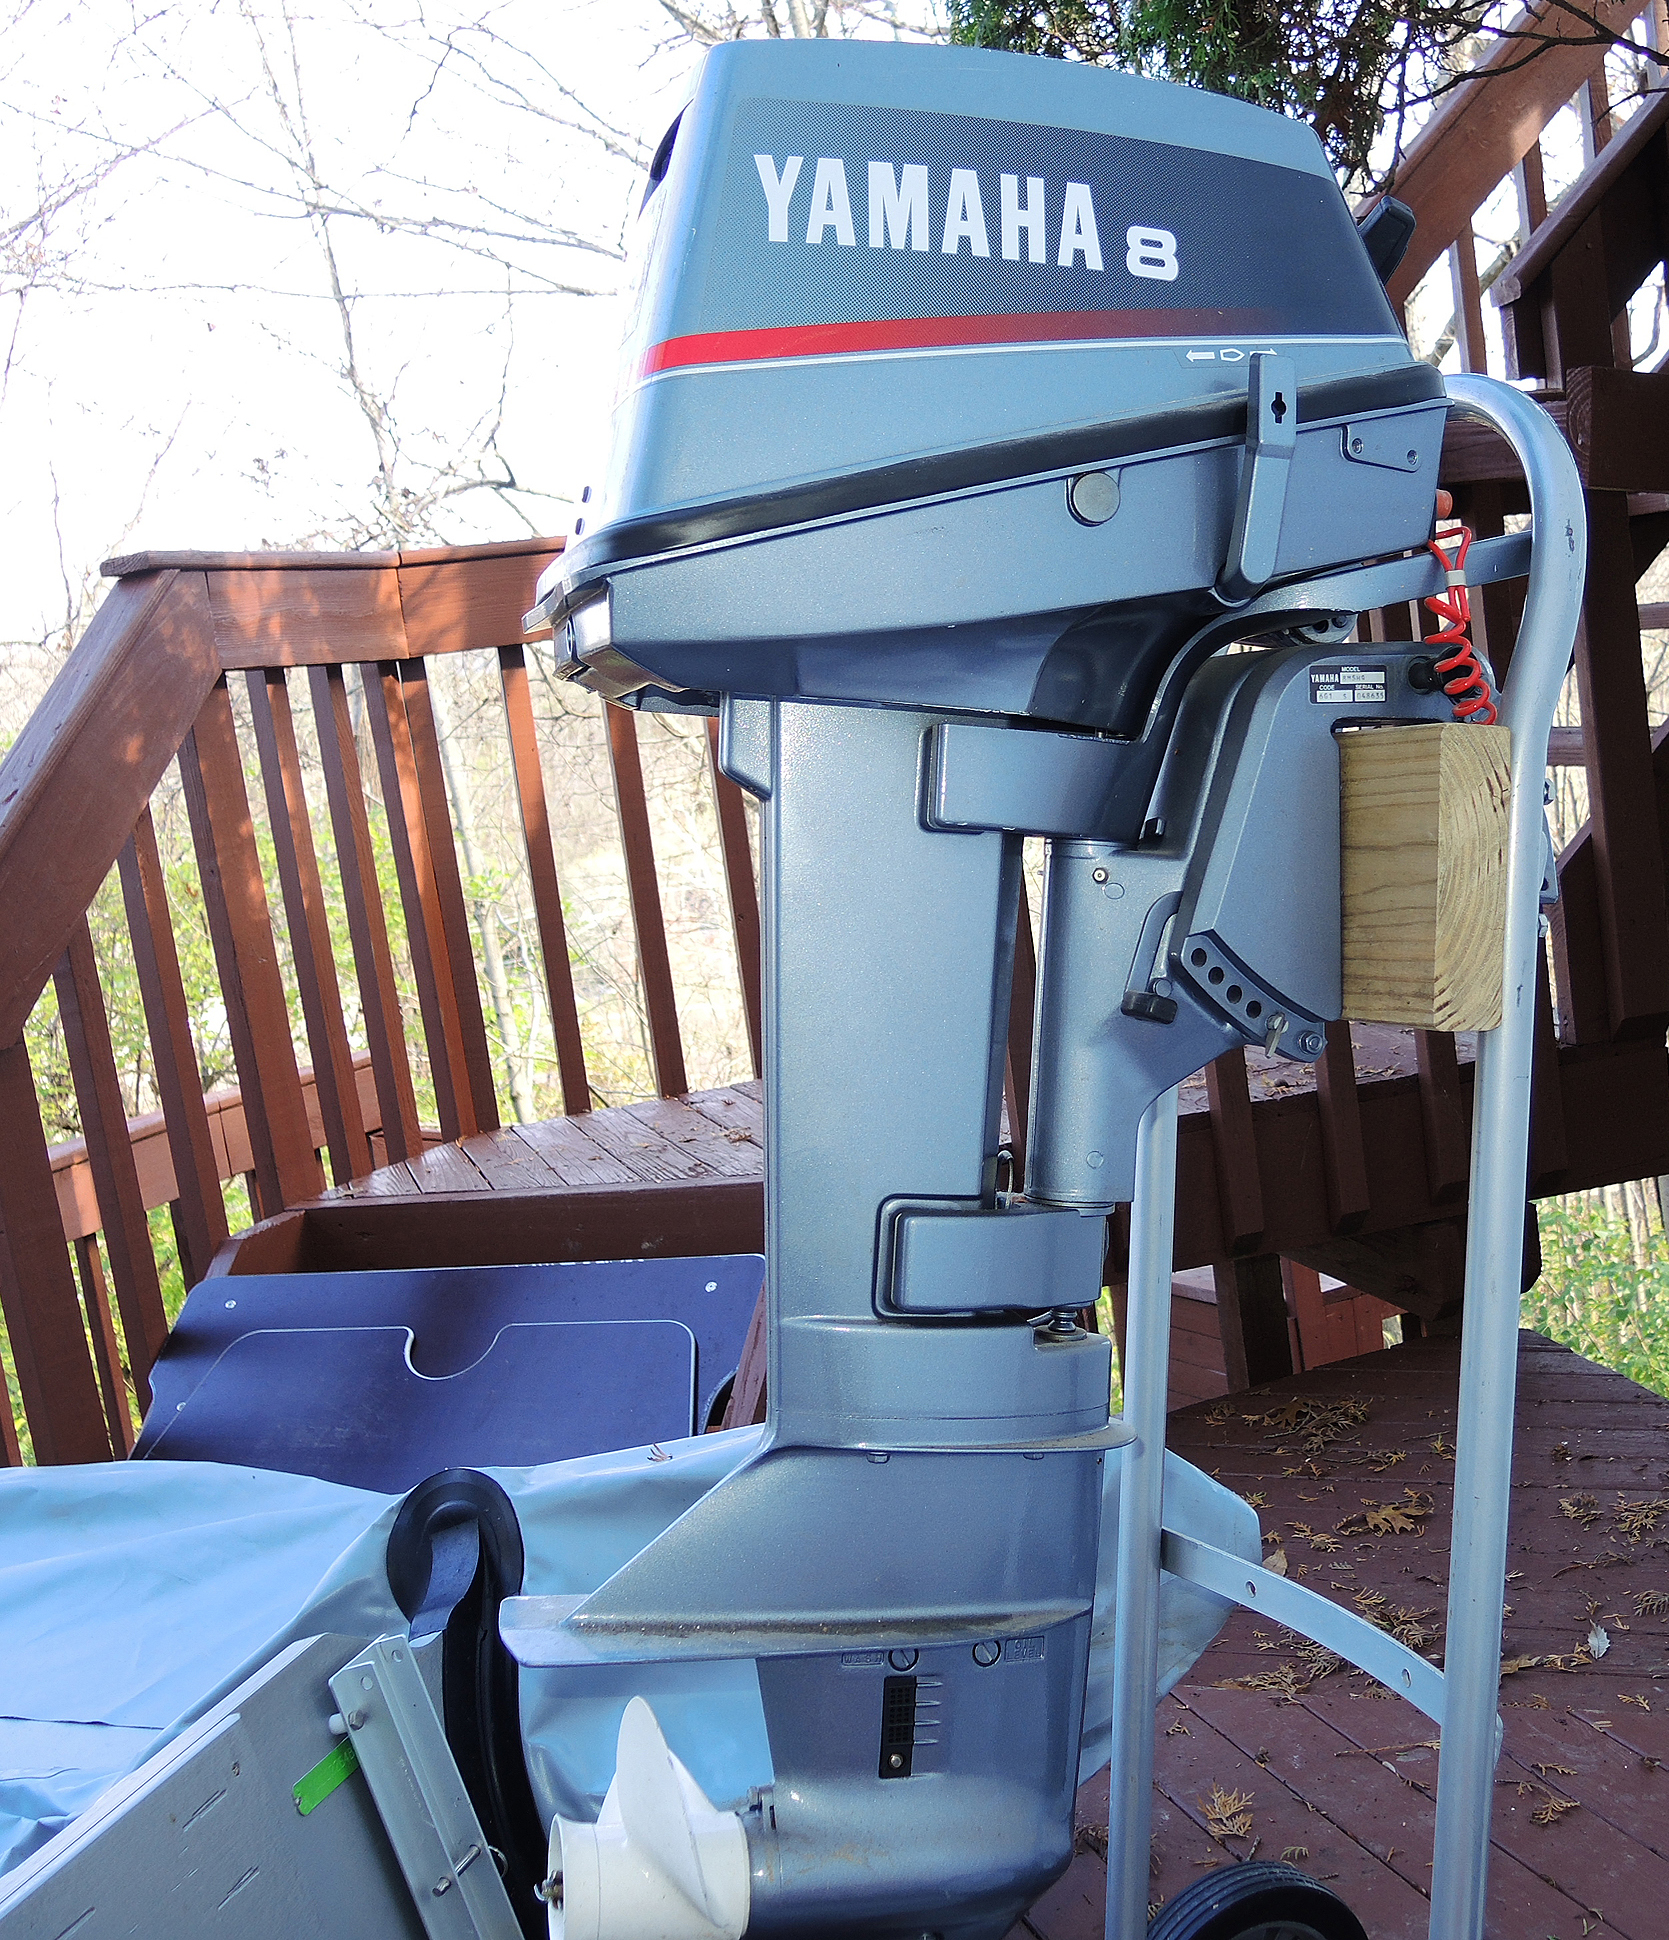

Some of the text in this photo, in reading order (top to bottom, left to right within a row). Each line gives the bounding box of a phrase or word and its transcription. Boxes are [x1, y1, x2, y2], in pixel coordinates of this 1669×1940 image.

[754, 154, 1178, 282] YAMAHA 8
[1310, 674, 1339, 683] YAMAHA
[1014, 1639, 1035, 1650] OIL
[1007, 1649, 1042, 1660] LEVEL
